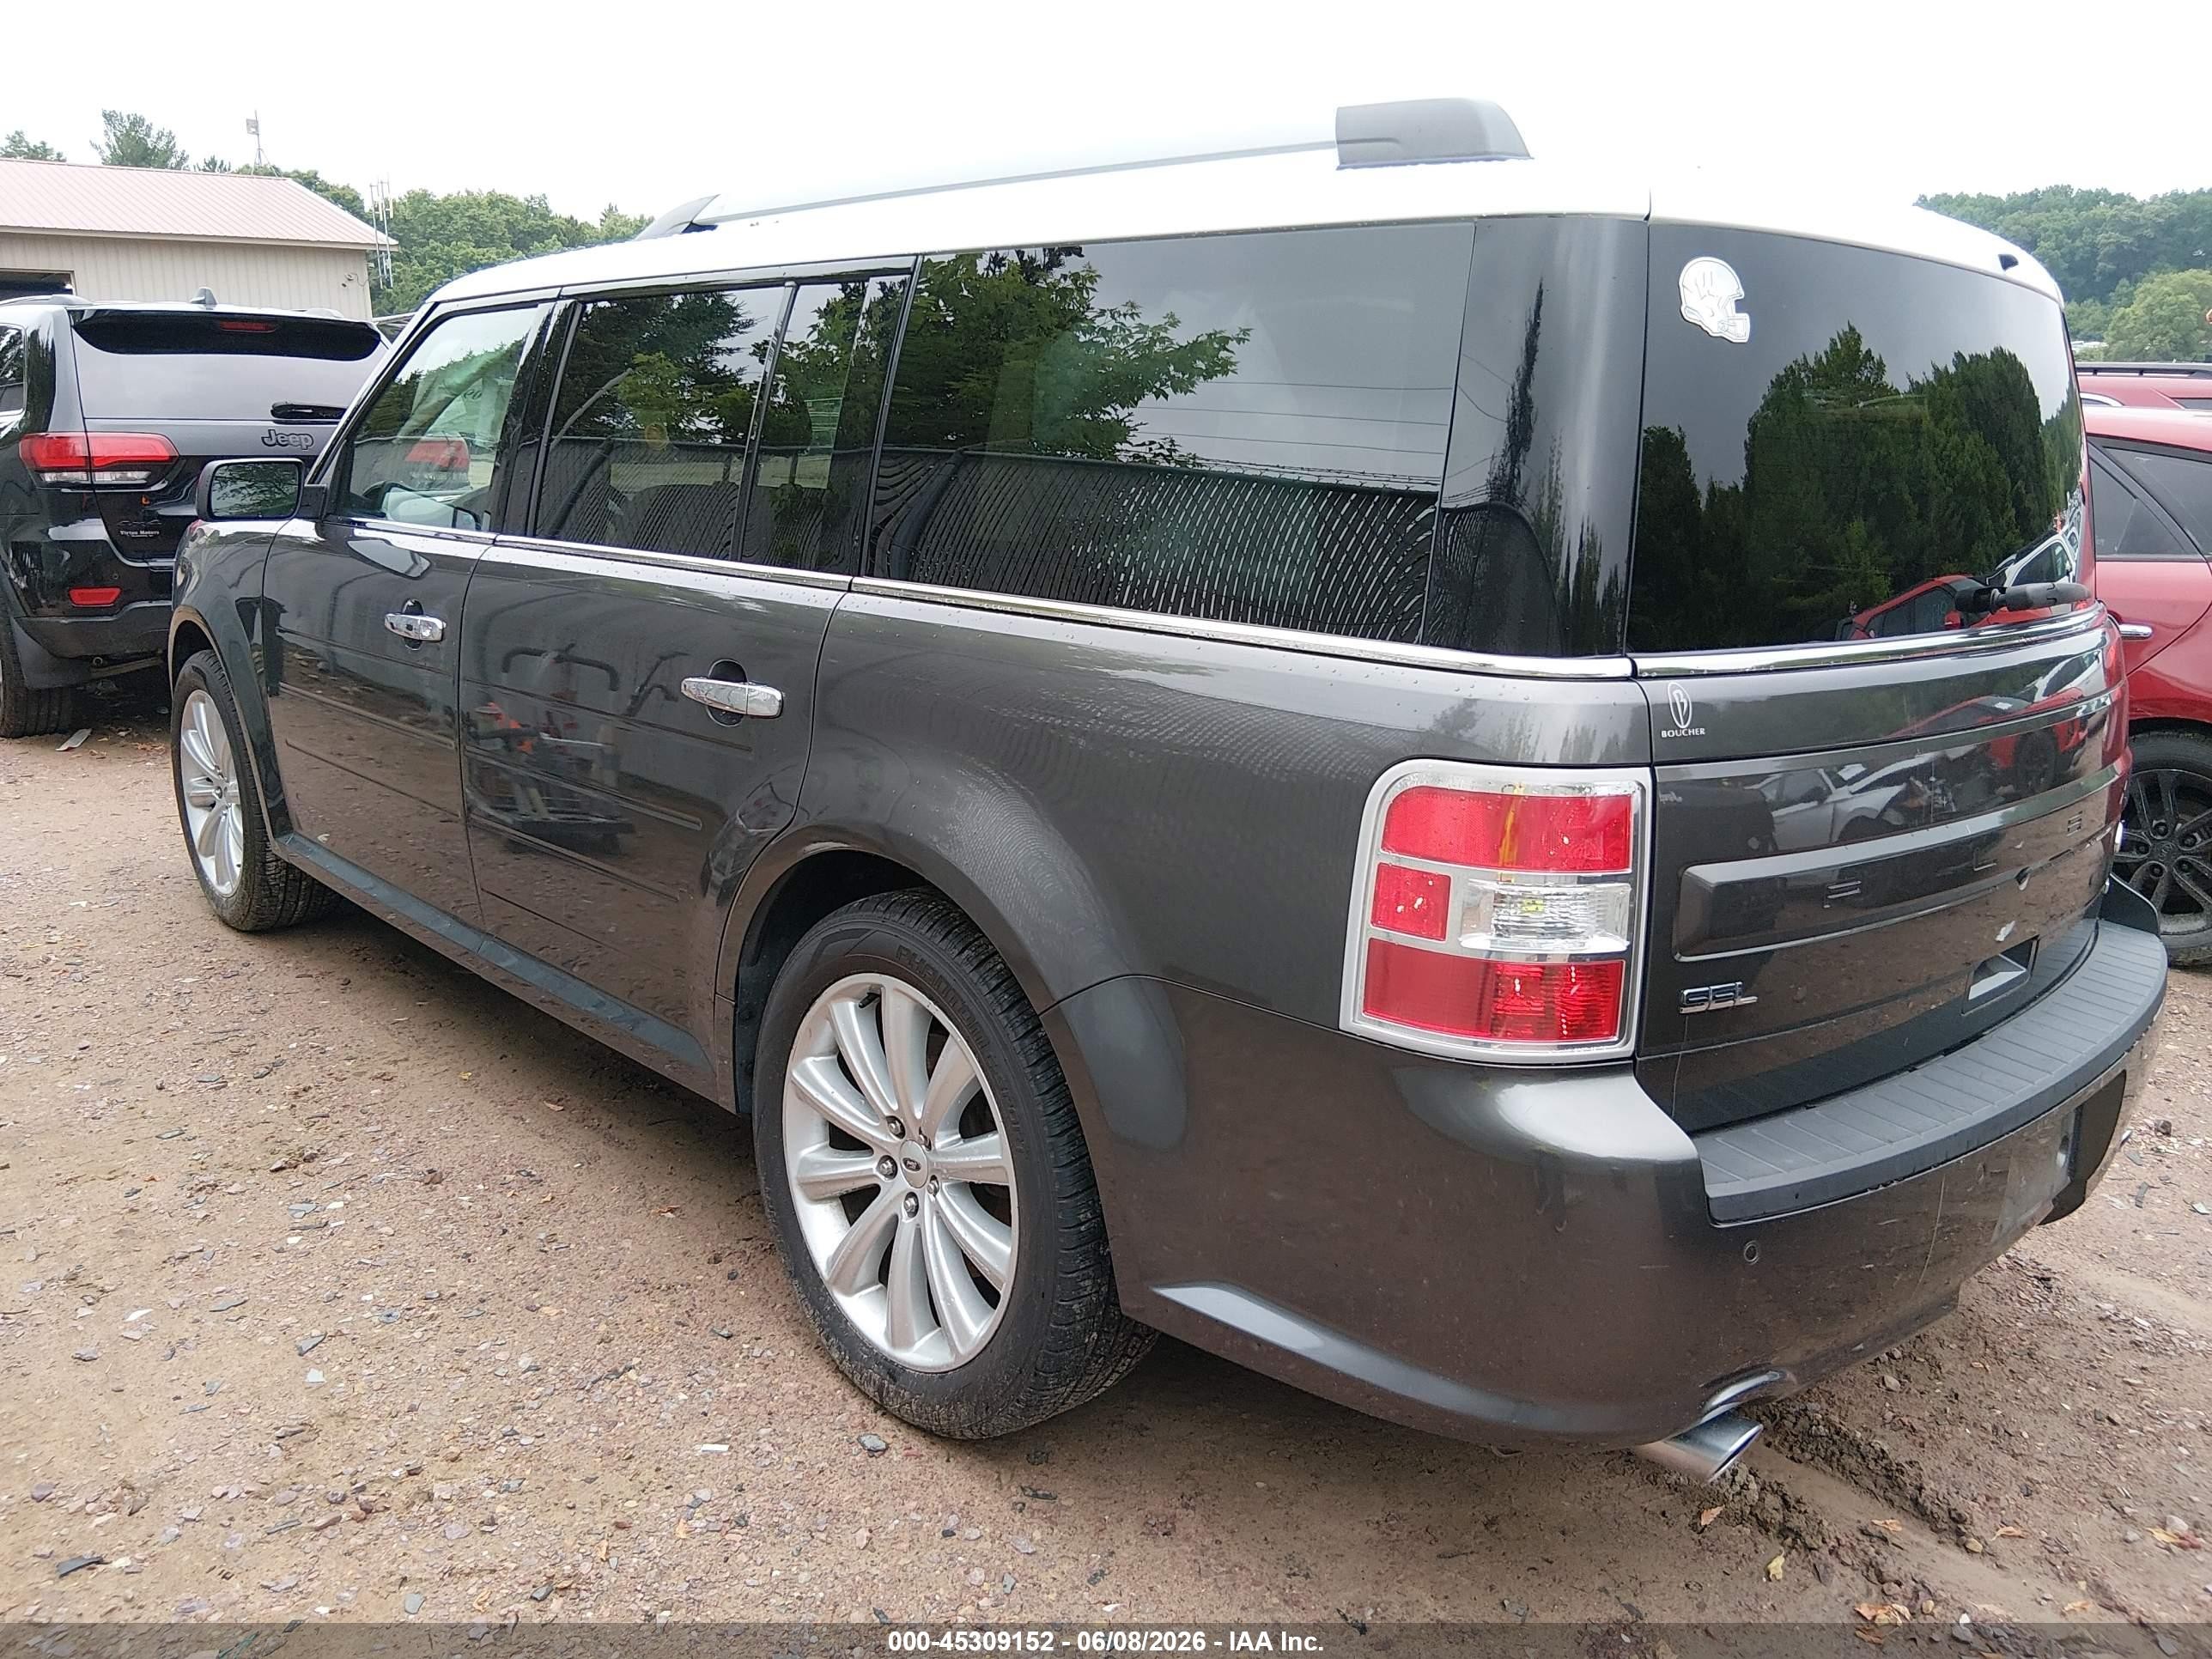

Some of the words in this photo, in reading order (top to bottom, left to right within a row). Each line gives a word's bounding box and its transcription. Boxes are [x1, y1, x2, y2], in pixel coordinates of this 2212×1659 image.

[261, 428, 314, 451] Jeep
[1661, 727, 1706, 738] BOUCHER
[1680, 981, 1759, 1014] SEL
